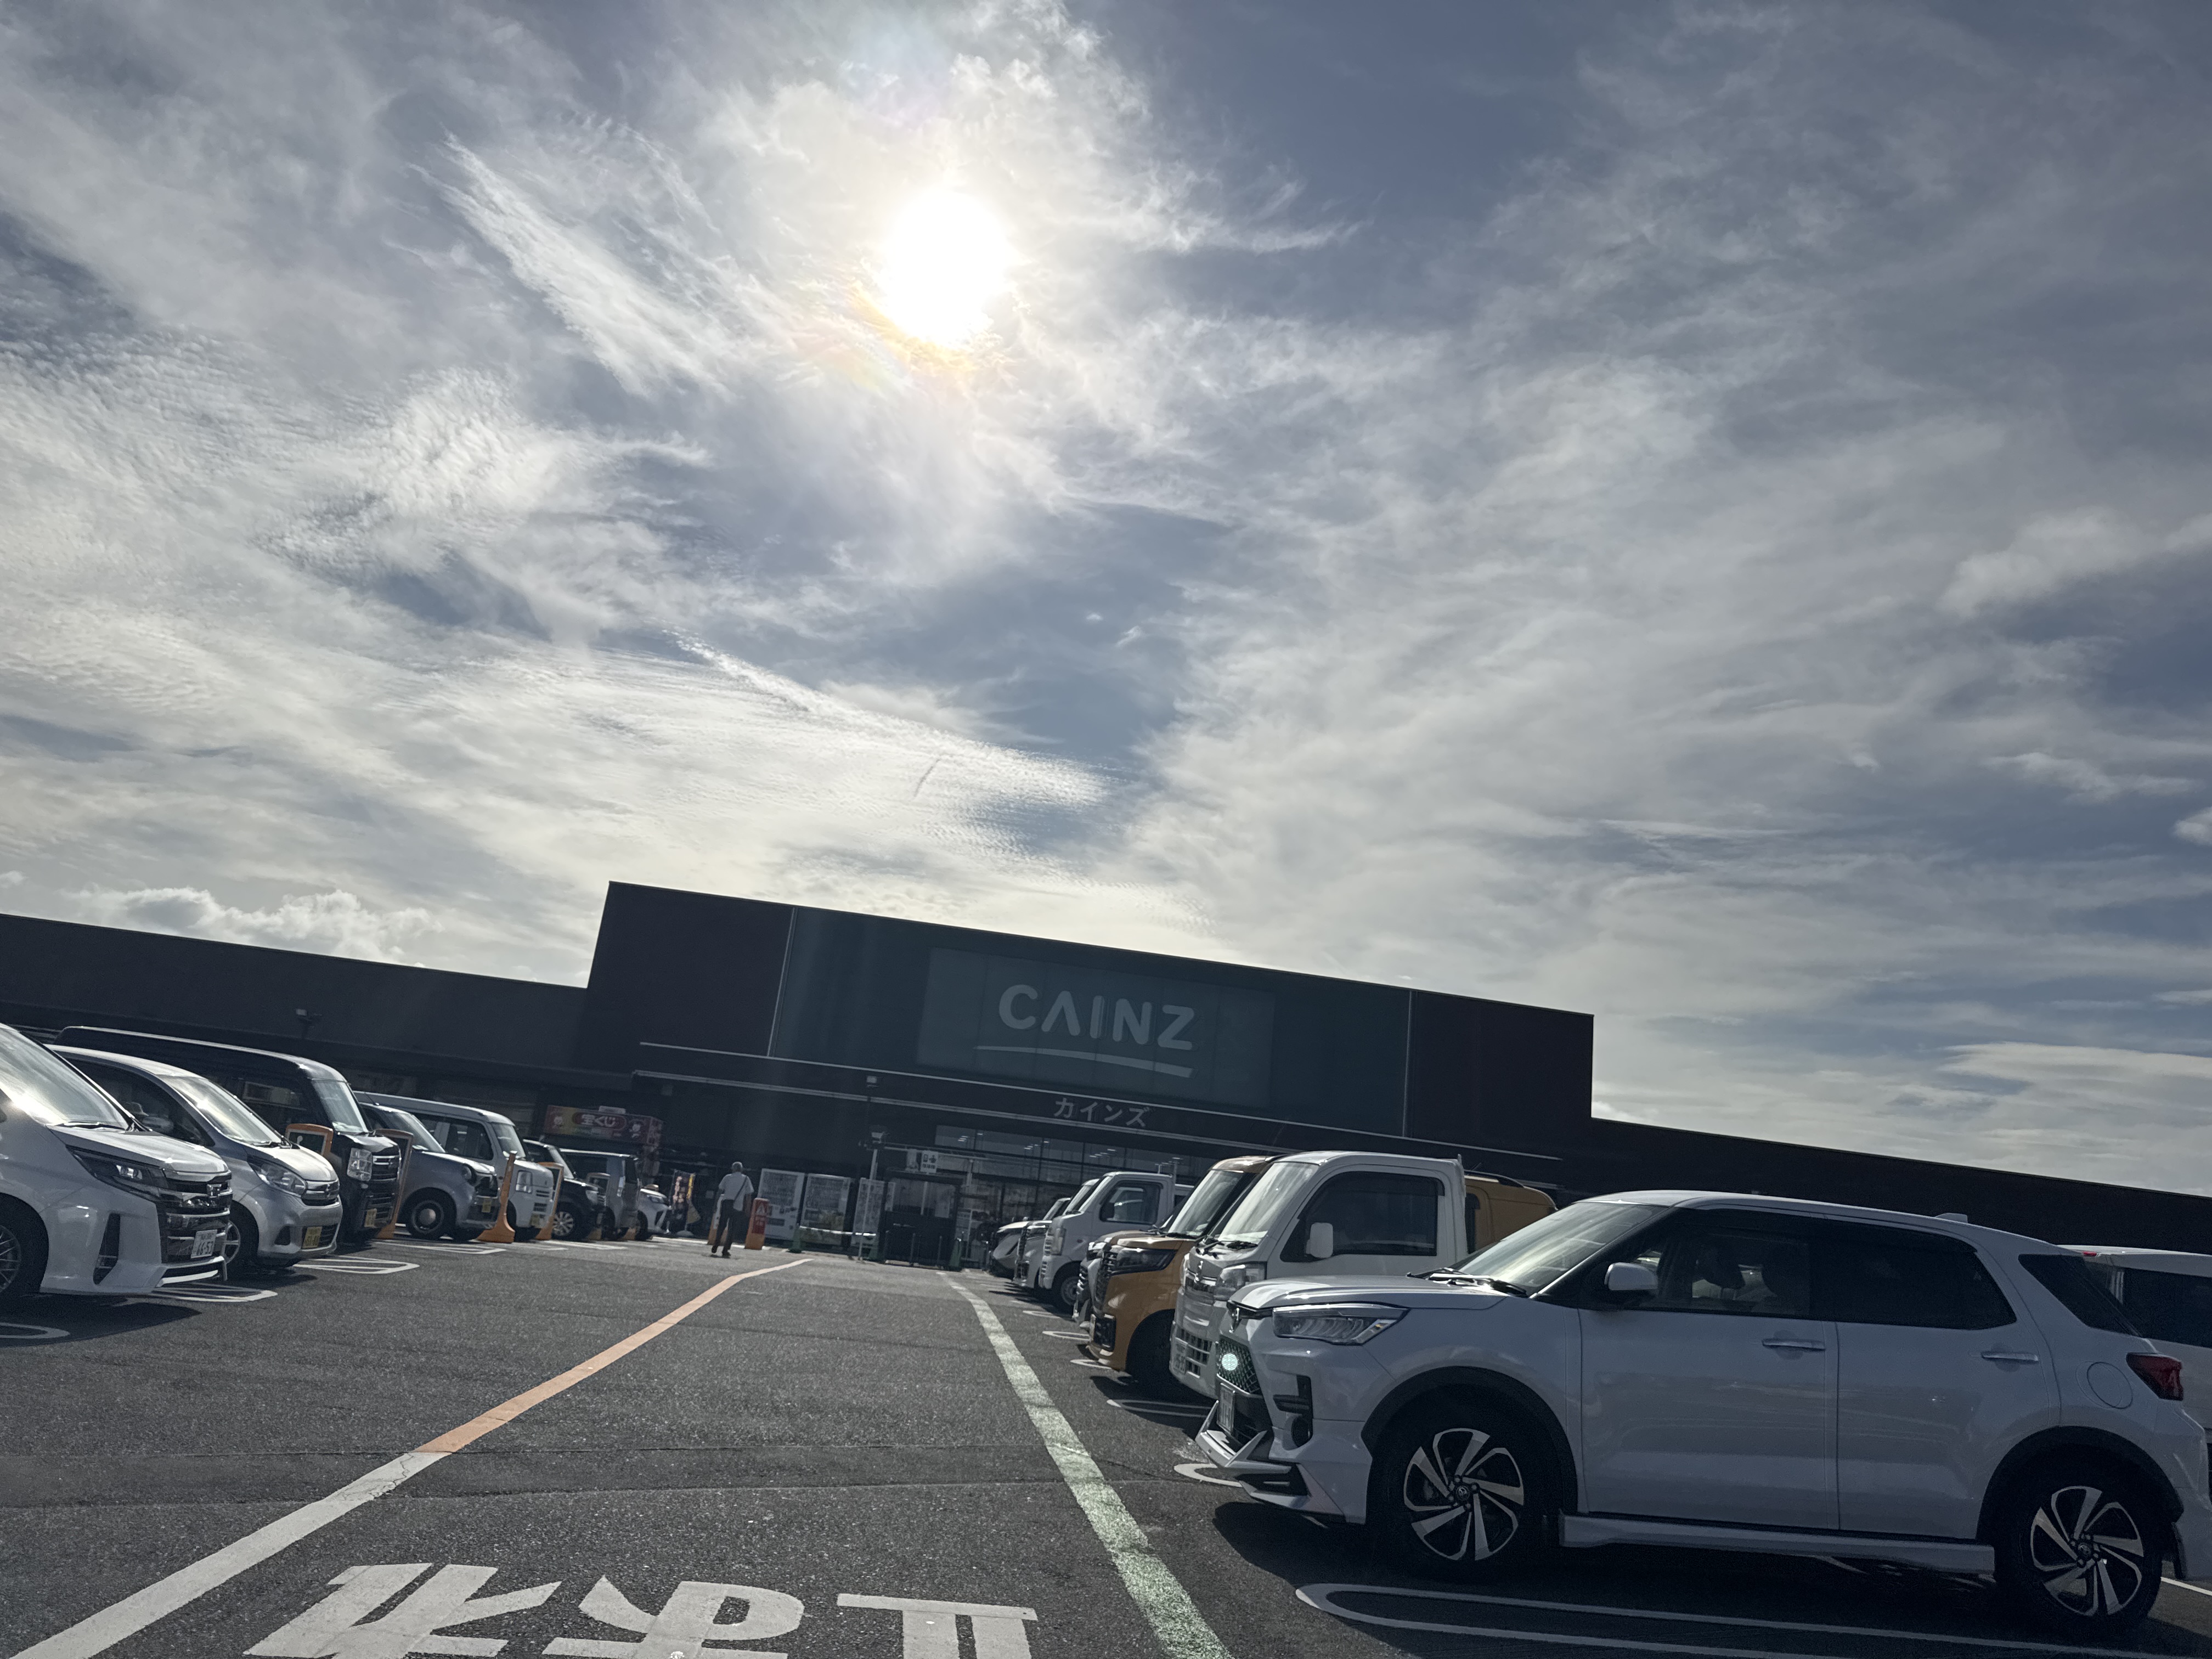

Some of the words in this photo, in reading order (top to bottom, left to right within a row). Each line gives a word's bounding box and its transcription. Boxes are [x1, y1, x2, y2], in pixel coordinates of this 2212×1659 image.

[998, 984, 1195, 1051] CAINZ
[581, 1114, 616, 1127] 宝くじ
[1053, 1098, 1150, 1127] カインズ
